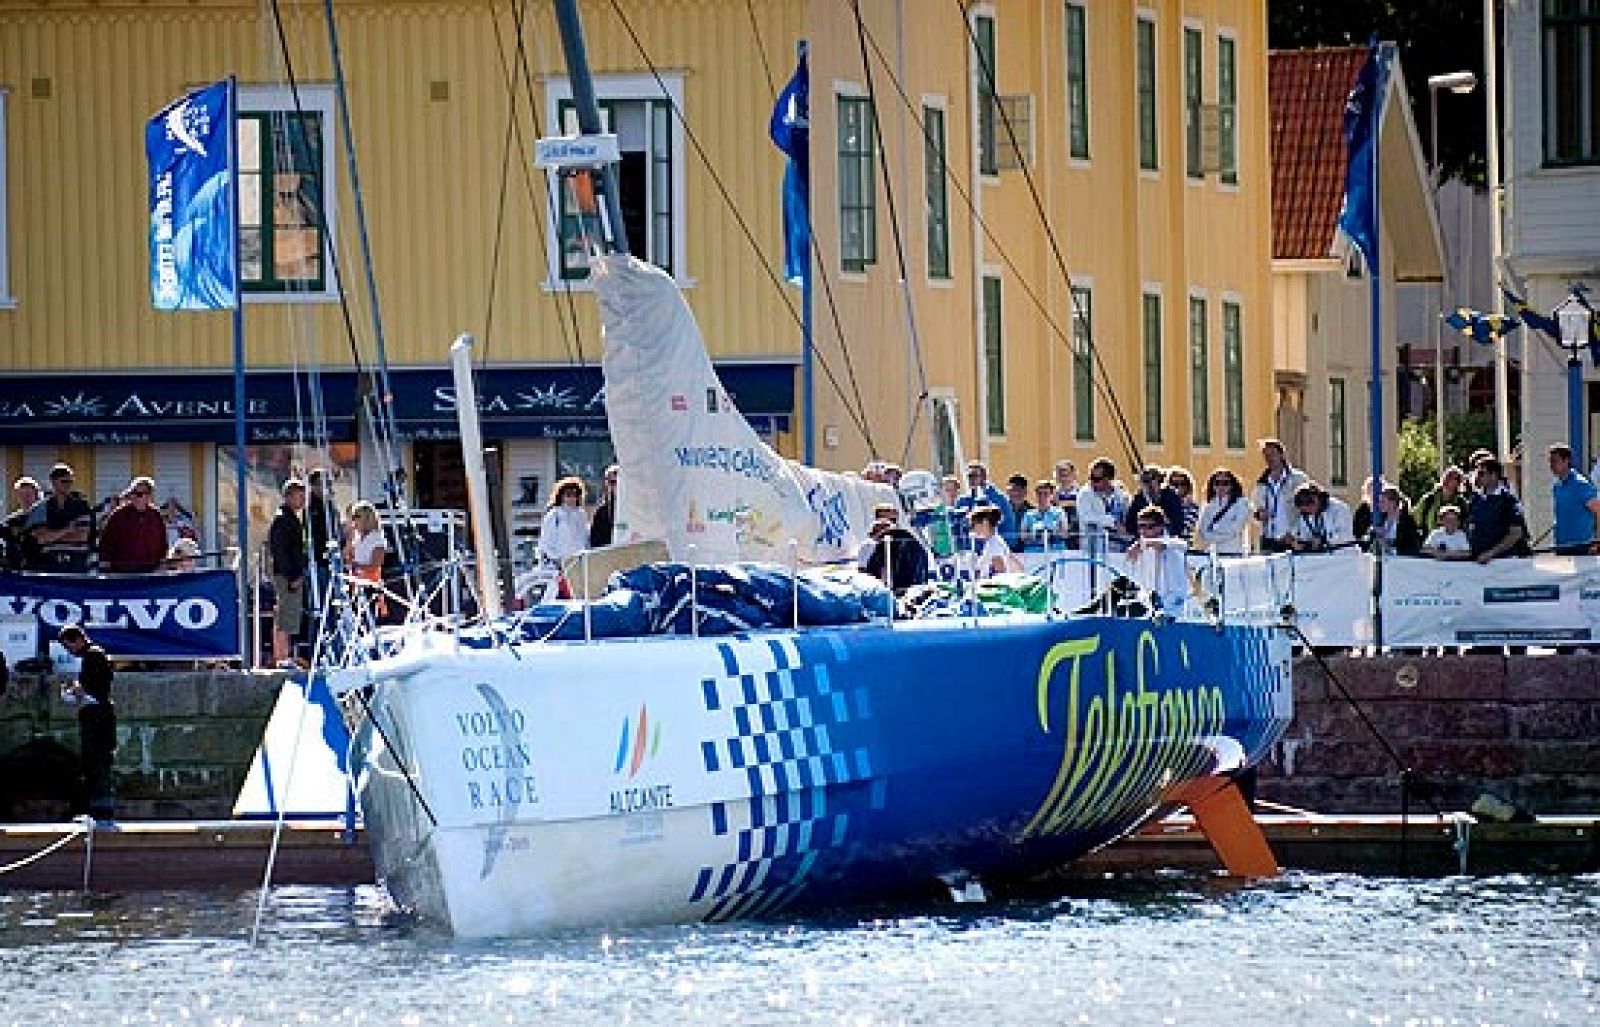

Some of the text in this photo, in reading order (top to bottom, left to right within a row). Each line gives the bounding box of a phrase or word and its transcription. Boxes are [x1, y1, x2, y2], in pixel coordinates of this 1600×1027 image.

[433, 386, 510, 411] SA
[0, 596, 219, 630] VOLVO
[456, 709, 526, 736] VOLVO
[462, 743, 532, 772] OCEAN
[467, 776, 539, 809] RACE
